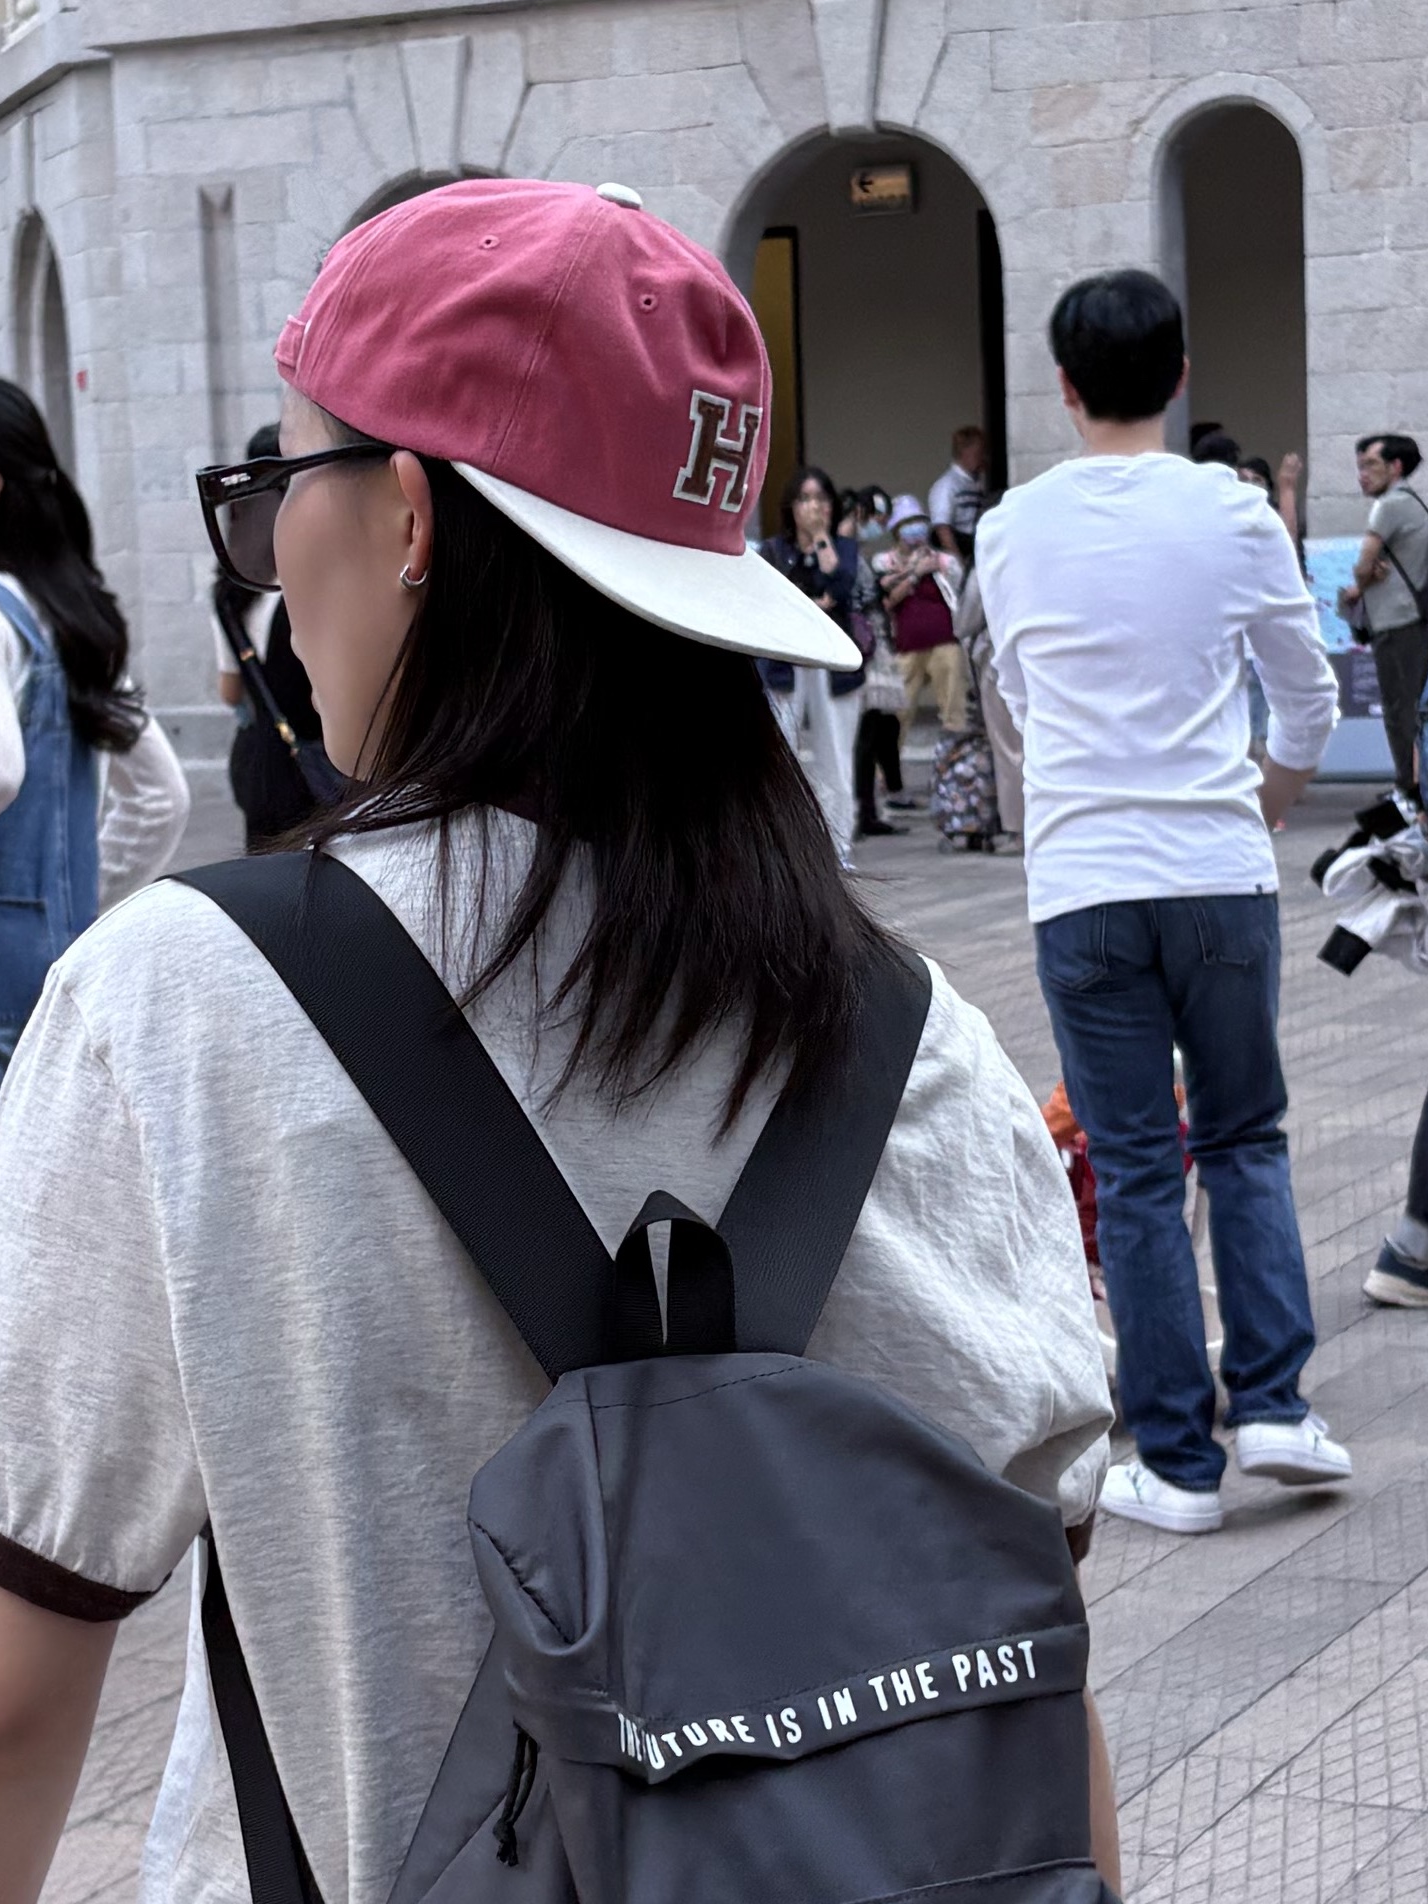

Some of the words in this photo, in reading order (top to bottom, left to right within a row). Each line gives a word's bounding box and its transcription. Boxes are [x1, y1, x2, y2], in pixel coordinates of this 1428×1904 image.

[673, 390, 762, 513] H
[642, 1715, 756, 1770] UTURE
[765, 1707, 802, 1748] IS
[817, 1687, 858, 1730] IN
[868, 1662, 940, 1712] THE
[951, 1640, 1037, 1693] PAST
